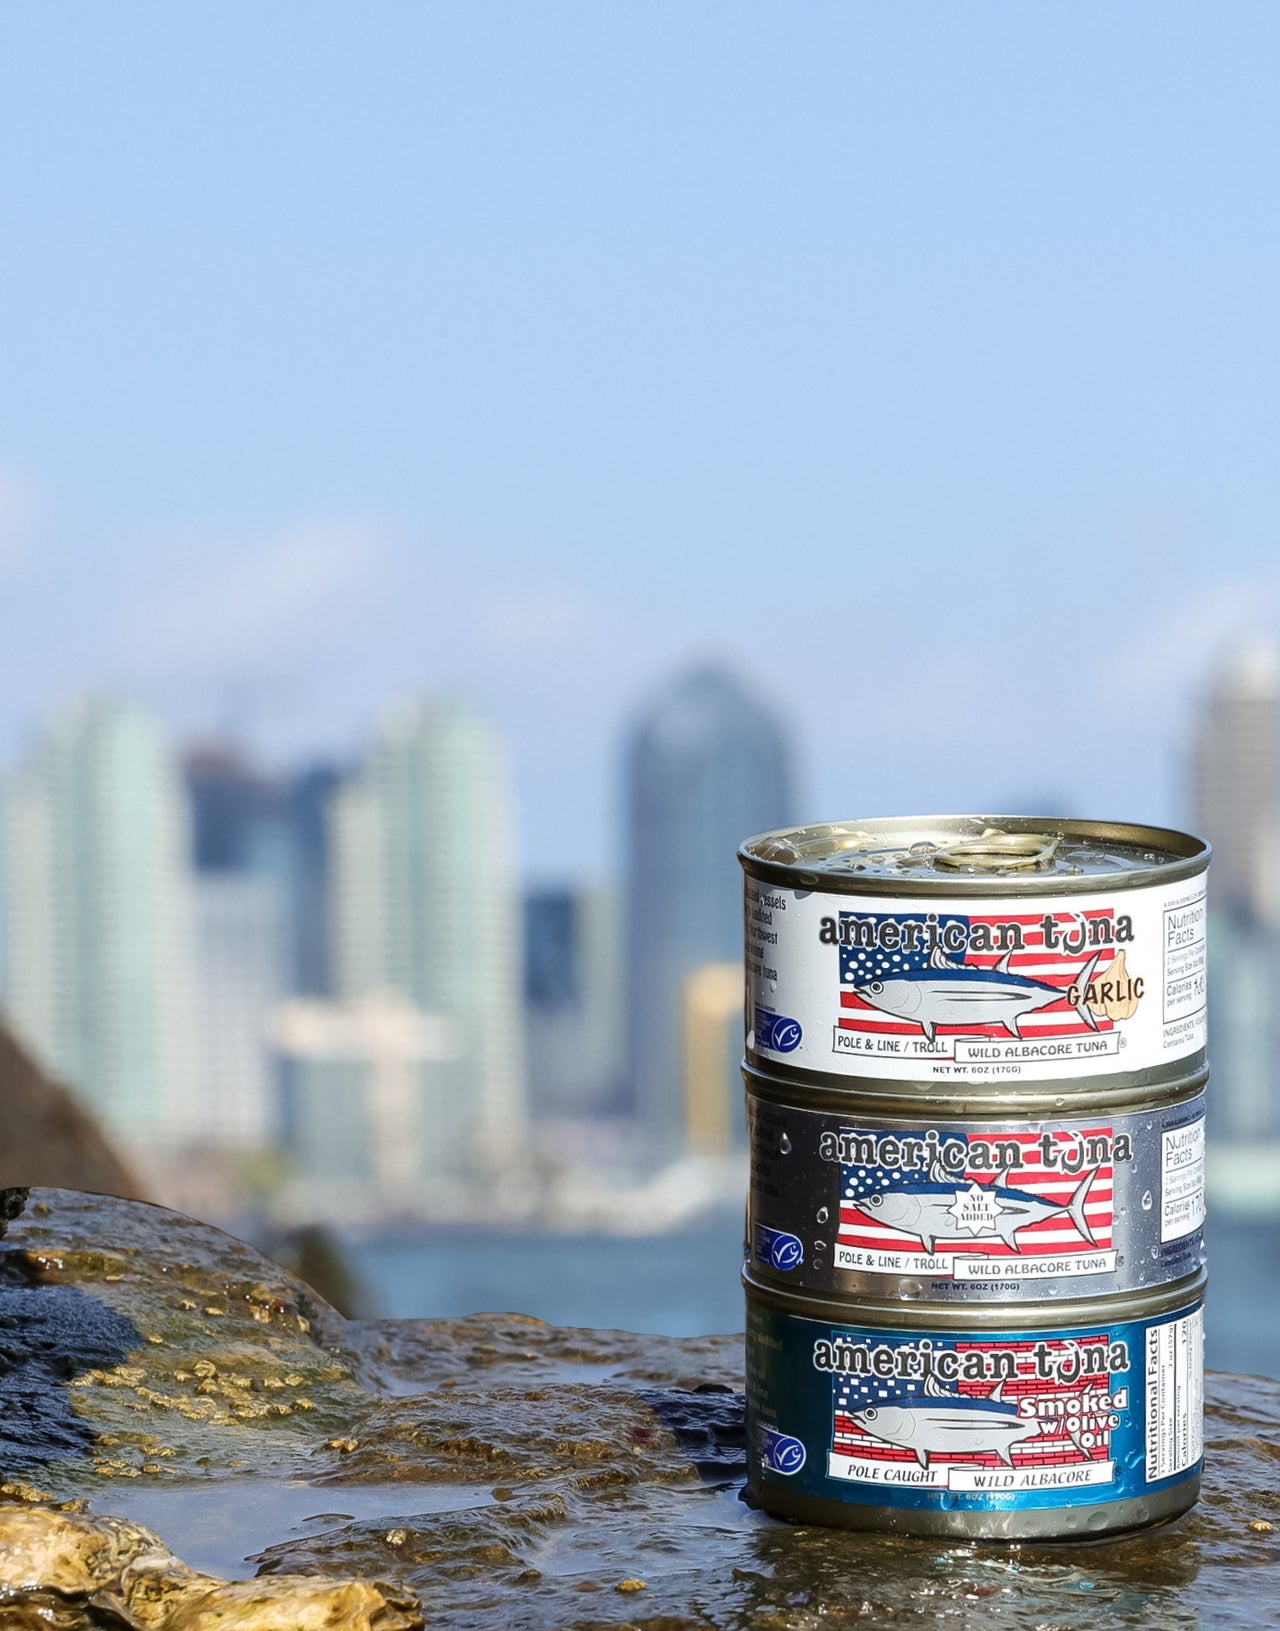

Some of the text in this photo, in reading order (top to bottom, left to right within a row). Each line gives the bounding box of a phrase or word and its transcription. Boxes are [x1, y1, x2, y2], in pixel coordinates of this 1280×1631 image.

[819, 913, 1135, 954] american tuna
[1168, 927, 1195, 947] Facts
[1067, 977, 1145, 1006] GARLIC
[1167, 979, 1192, 997] Calories
[838, 1035, 862, 1049] POLE
[865, 1038, 874, 1050] &
[877, 1040, 901, 1053] LINE
[912, 1041, 948, 1053] TROLL
[968, 1040, 1108, 1058] WILD ALBACORE TUNA
[819, 1130, 1025, 1171] american
[1038, 1131, 1133, 1173] tuna
[1166, 1148, 1193, 1167] Facts
[963, 1203, 990, 1211] SALT
[970, 1194, 984, 1202] NO
[961, 1213, 993, 1221] ADDED
[839, 1251, 863, 1264] POLE
[866, 1254, 875, 1266] &
[878, 1256, 902, 1268] LINE
[913, 1258, 949, 1269] TROLL
[968, 1258, 1107, 1275] WILD ALBACORE TUNA
[931, 1282, 950, 1290] NET
[813, 1340, 1130, 1384] american tuna
[1019, 1387, 1130, 1418] Smoked
[1147, 1328, 1158, 1480] Nutritional Facts
[1080, 1431, 1110, 1448] Oil
[848, 1464, 938, 1482] POLE CAUGHT
[974, 1469, 1093, 1487] WILD ALBACORE
